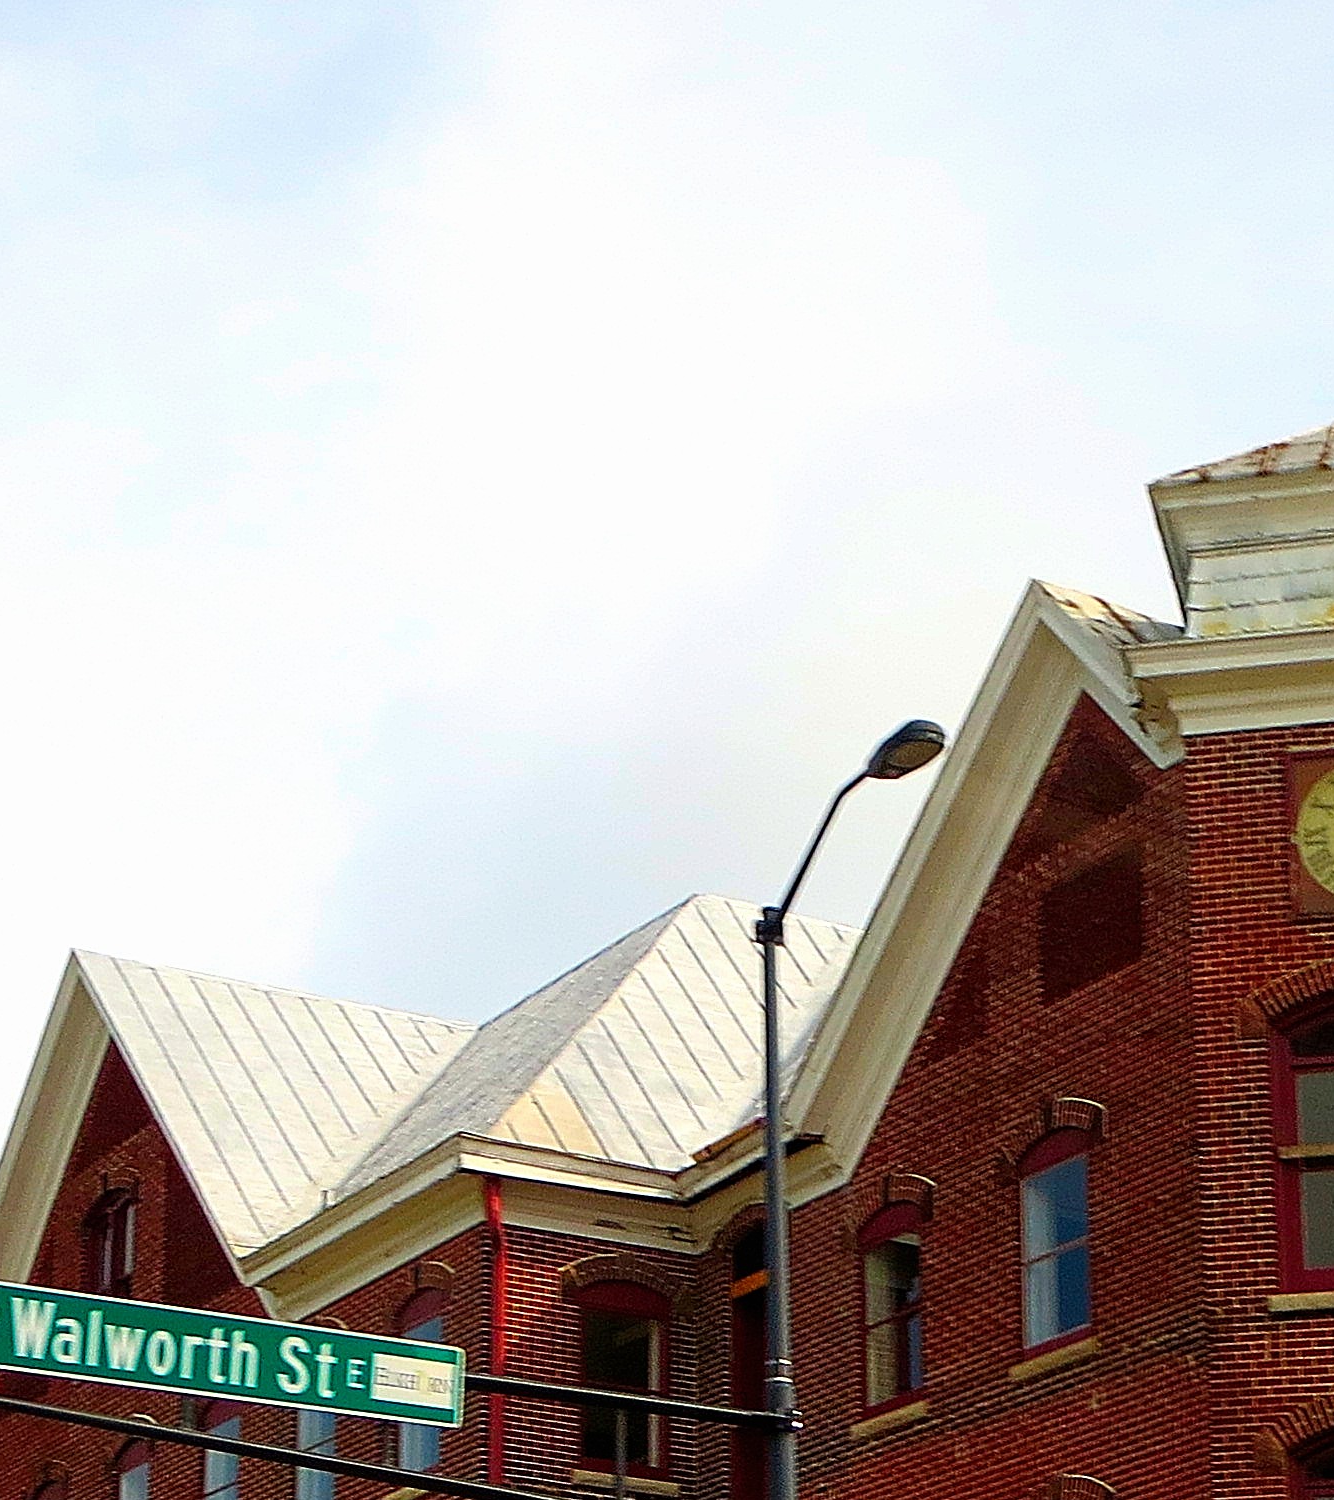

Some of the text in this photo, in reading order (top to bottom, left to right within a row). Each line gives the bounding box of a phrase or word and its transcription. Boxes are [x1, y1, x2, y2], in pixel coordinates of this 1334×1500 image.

[10, 1296, 260, 1390] Walworth
[276, 1336, 339, 1400] St
[347, 1357, 368, 1391] E
